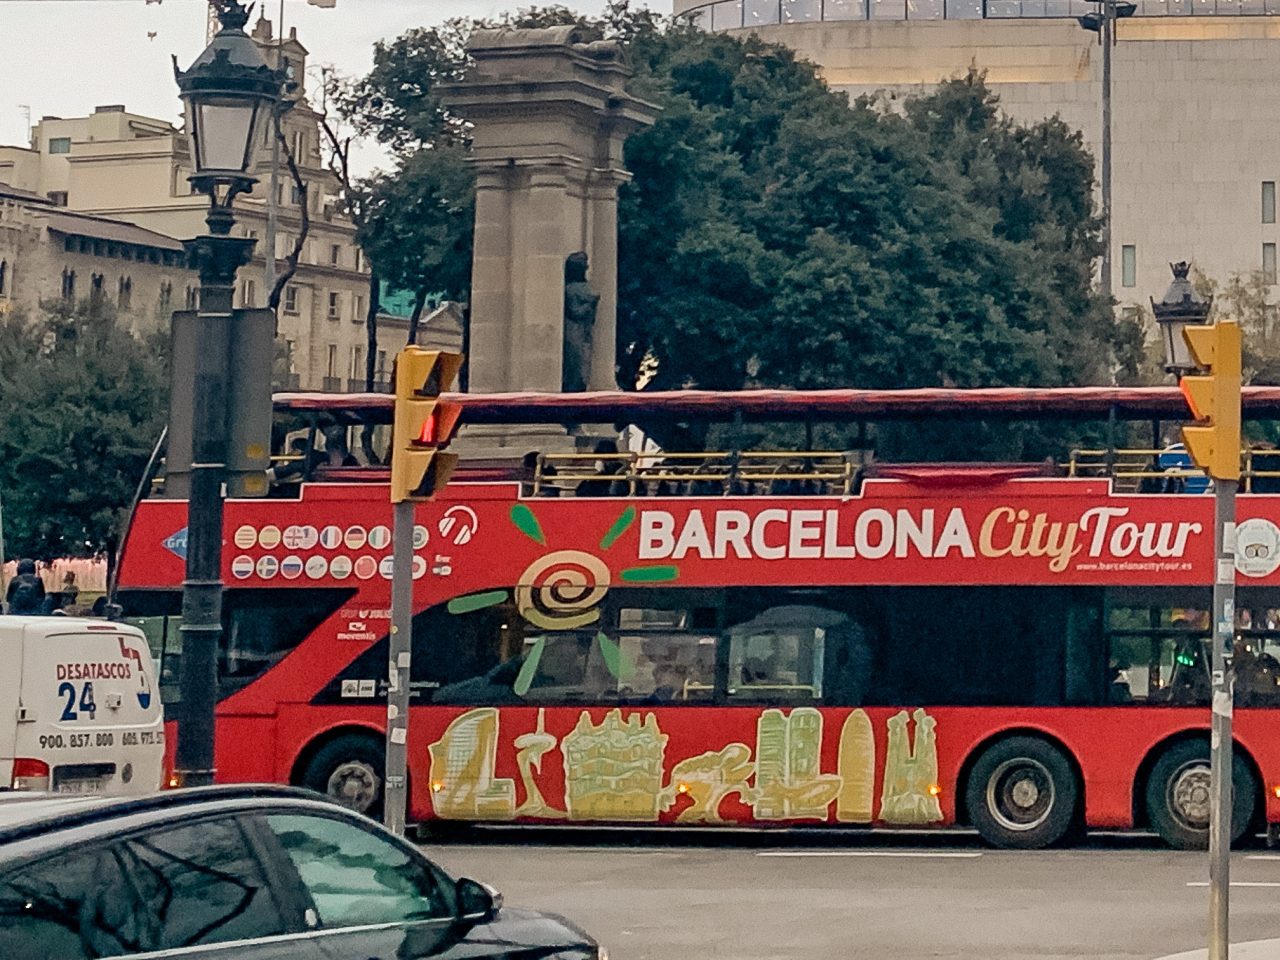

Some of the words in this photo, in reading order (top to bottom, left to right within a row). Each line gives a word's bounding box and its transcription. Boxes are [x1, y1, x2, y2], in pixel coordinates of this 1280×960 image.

[638, 508, 976, 559] BARCELONA
[979, 506, 1082, 572] City
[1080, 506, 1202, 558] Tour
[1076, 561, 1193, 572] www.barcelonacitytour.es
[57, 663, 131, 680] DESATASCOS
[58, 681, 96, 721] 24
